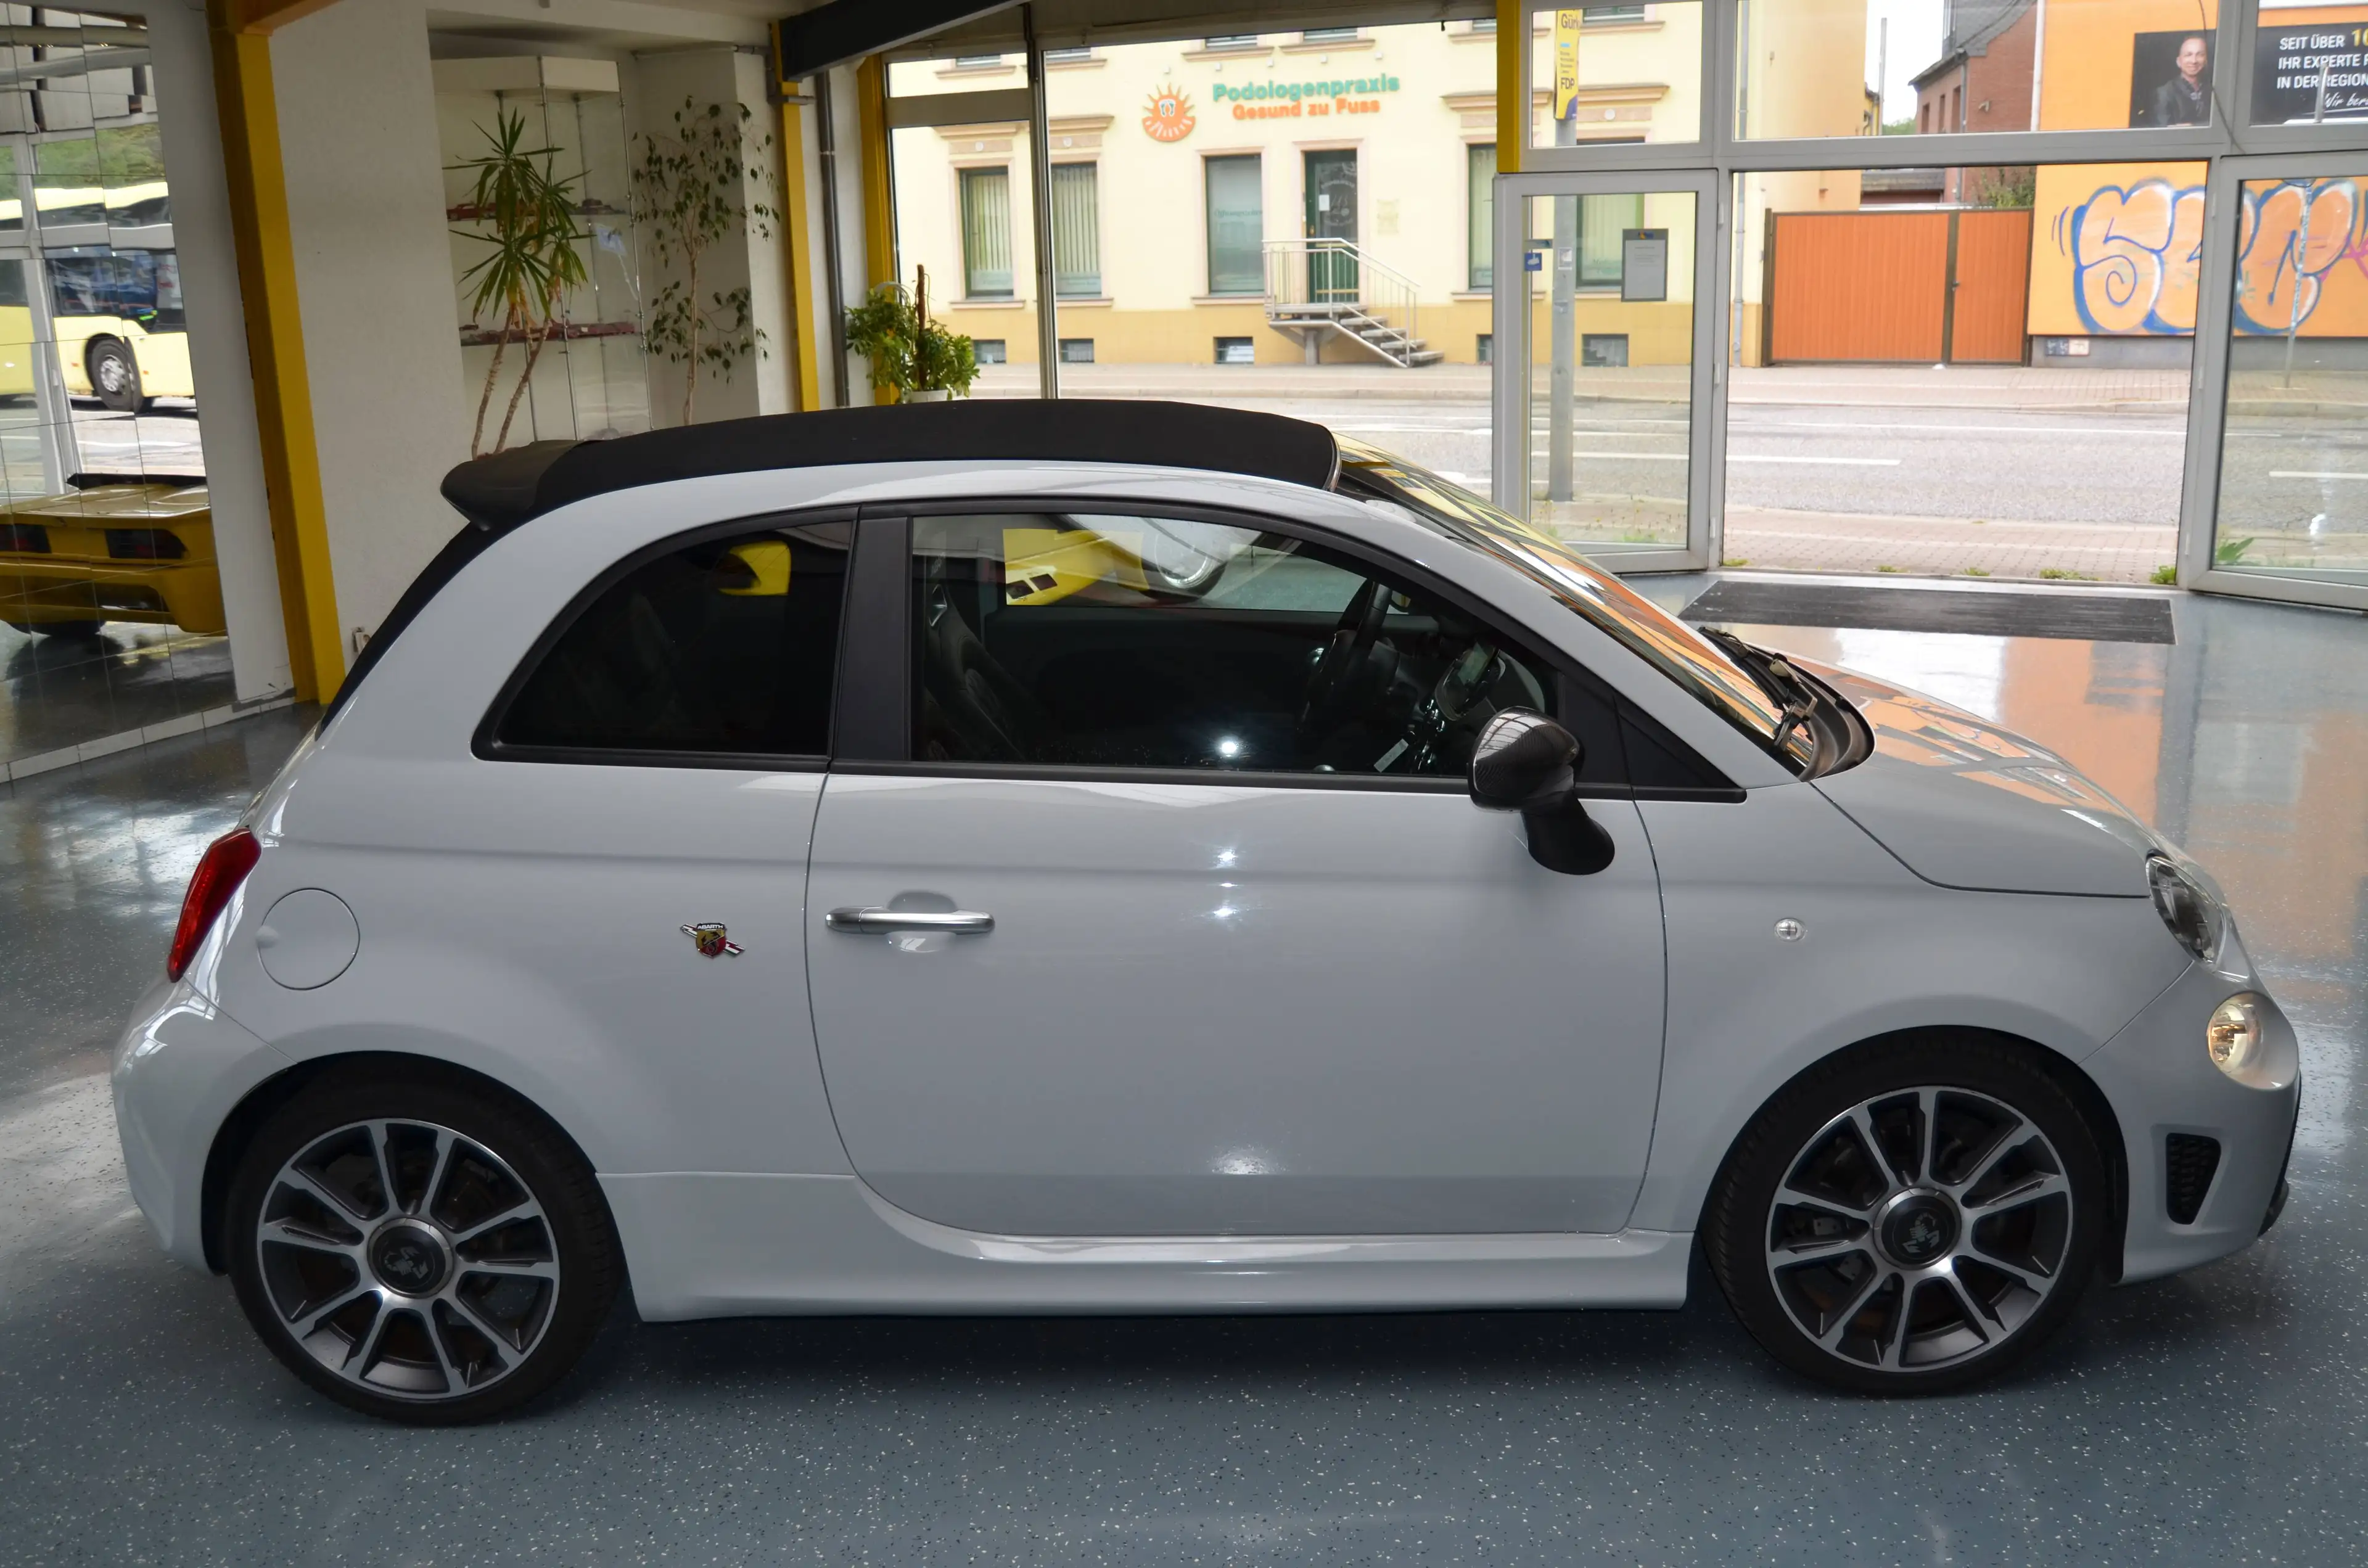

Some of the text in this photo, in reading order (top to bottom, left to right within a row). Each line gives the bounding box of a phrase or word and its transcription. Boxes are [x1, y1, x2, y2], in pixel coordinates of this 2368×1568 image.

[2279, 36, 2309, 50] SEIT
[2311, 33, 2346, 49] ÜBER
[2278, 56, 2301, 70] IHR
[2303, 53, 2362, 69] EXPERTE
[1212, 73, 1400, 102] Podologenpraxis
[1561, 77, 1575, 90] FDP
[2277, 76, 2291, 89] IN
[2294, 75, 2319, 88] DER
[1233, 97, 1380, 120] Gesund zu Fuss
